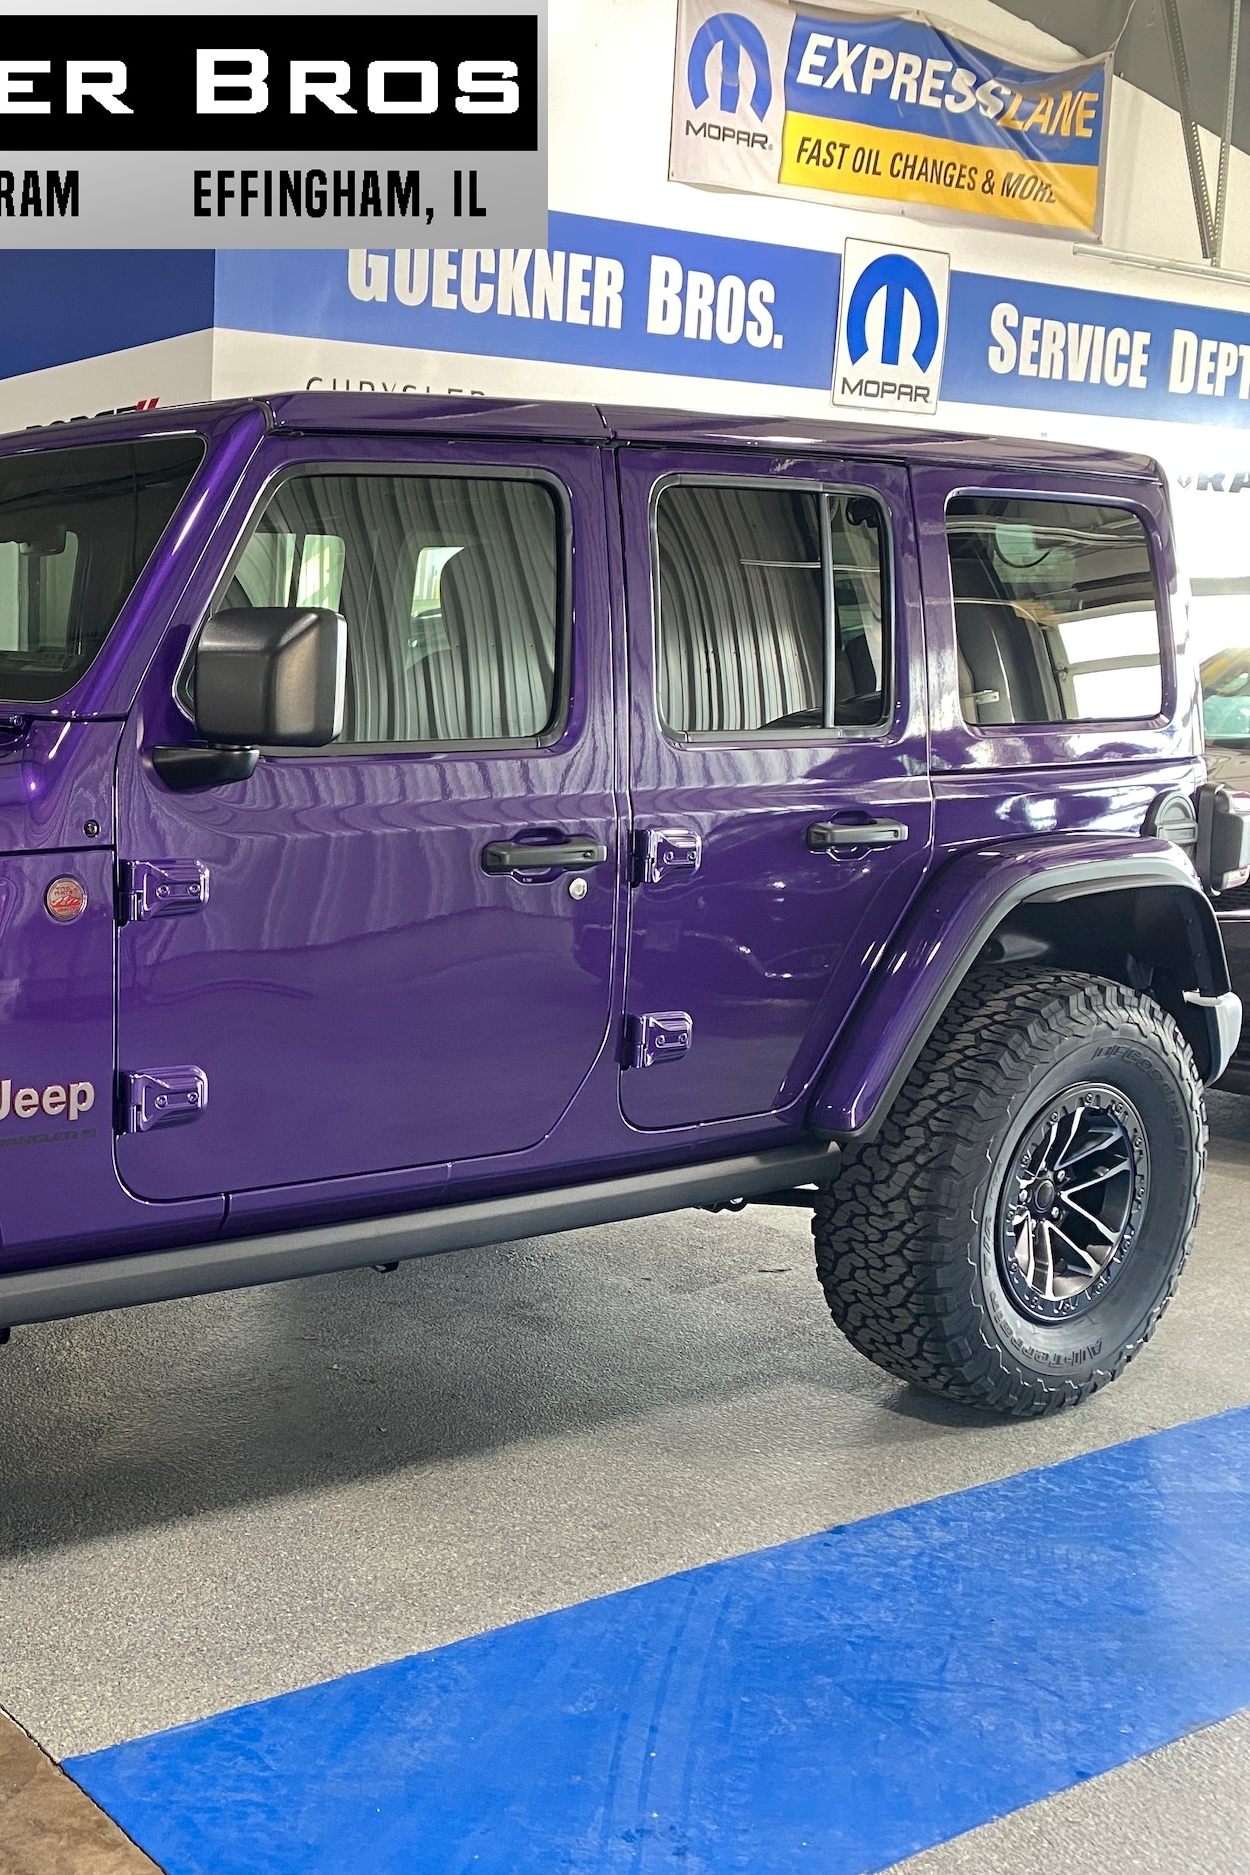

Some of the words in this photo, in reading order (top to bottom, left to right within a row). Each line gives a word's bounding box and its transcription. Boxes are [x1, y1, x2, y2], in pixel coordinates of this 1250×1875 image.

[685, 119, 768, 150] MOPAR
[796, 136, 850, 170] FAST
[852, 146, 882, 176] OIL
[889, 152, 978, 191] CHANGES
[981, 169, 995, 195] &
[647, 255, 783, 349] BROS.
[988, 302, 1150, 389] SERVICE
[842, 377, 930, 404] MOPAR
